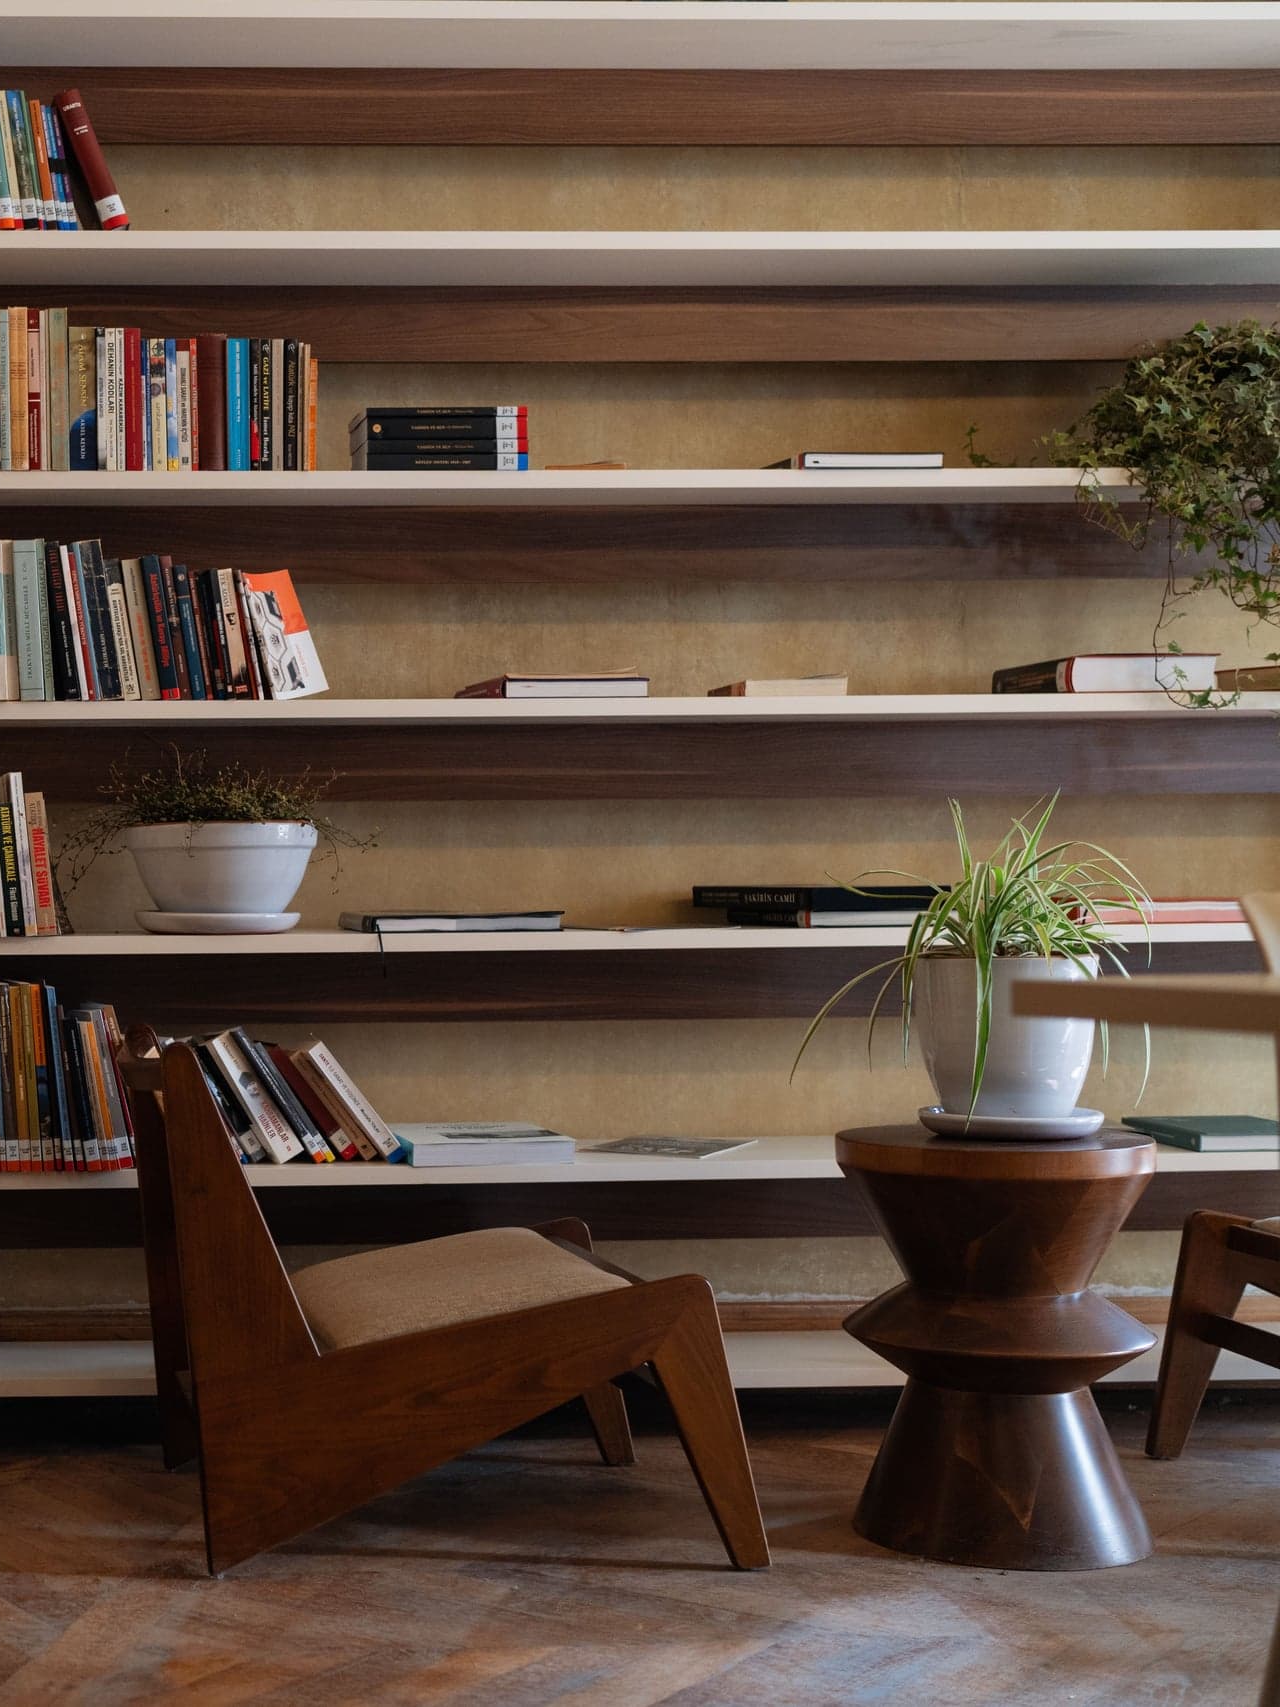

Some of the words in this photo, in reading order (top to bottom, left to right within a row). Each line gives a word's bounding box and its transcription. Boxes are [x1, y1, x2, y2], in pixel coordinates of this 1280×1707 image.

[107, 378, 115, 414] KODLARI
[0, 806, 12, 835] ATATÜRK
[3, 835, 13, 845] VE
[31, 828, 47, 869] HAYALET
[2, 845, 17, 882] ÇANAKKALE
[35, 870, 51, 908] SÜVARİ
